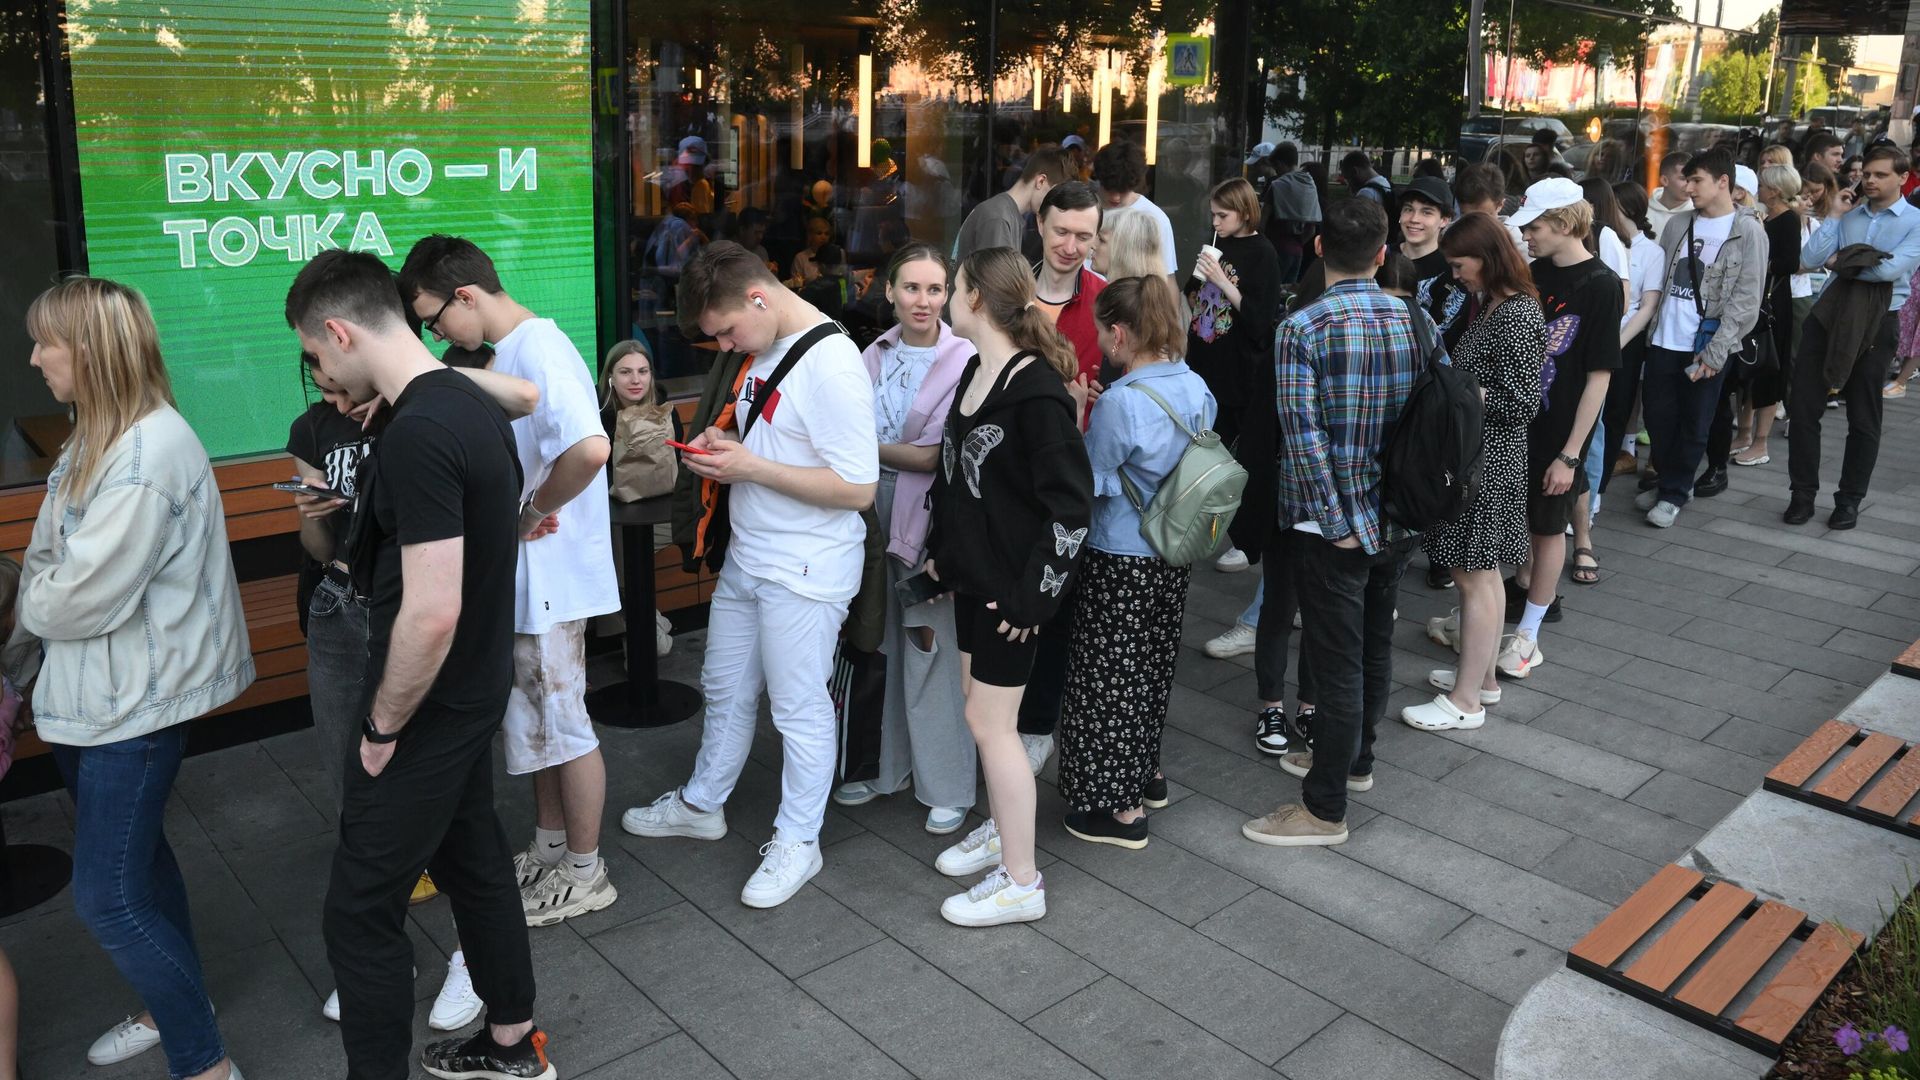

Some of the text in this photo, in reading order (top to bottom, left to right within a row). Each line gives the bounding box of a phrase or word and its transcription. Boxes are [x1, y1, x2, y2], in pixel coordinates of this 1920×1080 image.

[165, 148, 433, 203] ВКУСНО
[498, 147, 537, 192] И
[163, 211, 394, 269] ТОЧКА
